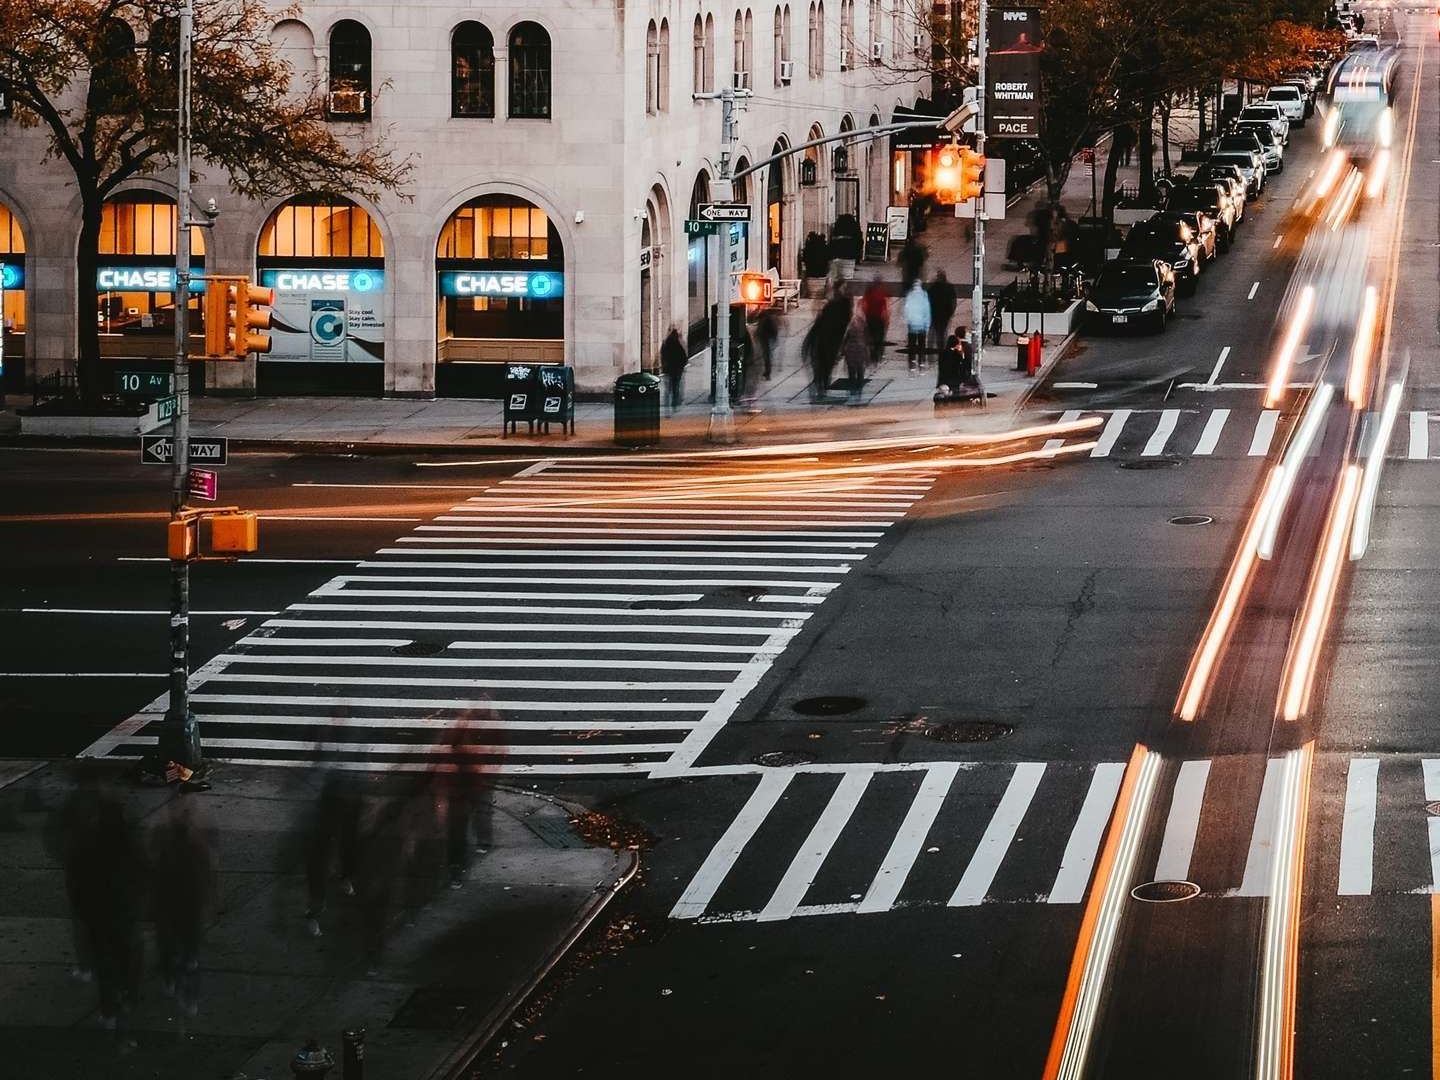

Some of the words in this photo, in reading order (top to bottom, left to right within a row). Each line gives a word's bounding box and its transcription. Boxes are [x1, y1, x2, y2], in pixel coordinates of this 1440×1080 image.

[1003, 11, 1028, 21] NYC
[995, 83, 1028, 91] ROBERT
[994, 92, 1033, 100] WHITMAN
[999, 123, 1028, 133] PACE
[706, 208, 721, 217] ONE
[728, 208, 745, 217] WAY
[688, 221, 700, 232] 10
[100, 270, 171, 287] CHASE
[277, 273, 350, 290] CHASE
[456, 275, 529, 293] CHASE
[122, 374, 140, 391] 10
[149, 375, 162, 385] Av
[155, 445, 173, 457] ON
[190, 445, 216, 456] WAY
